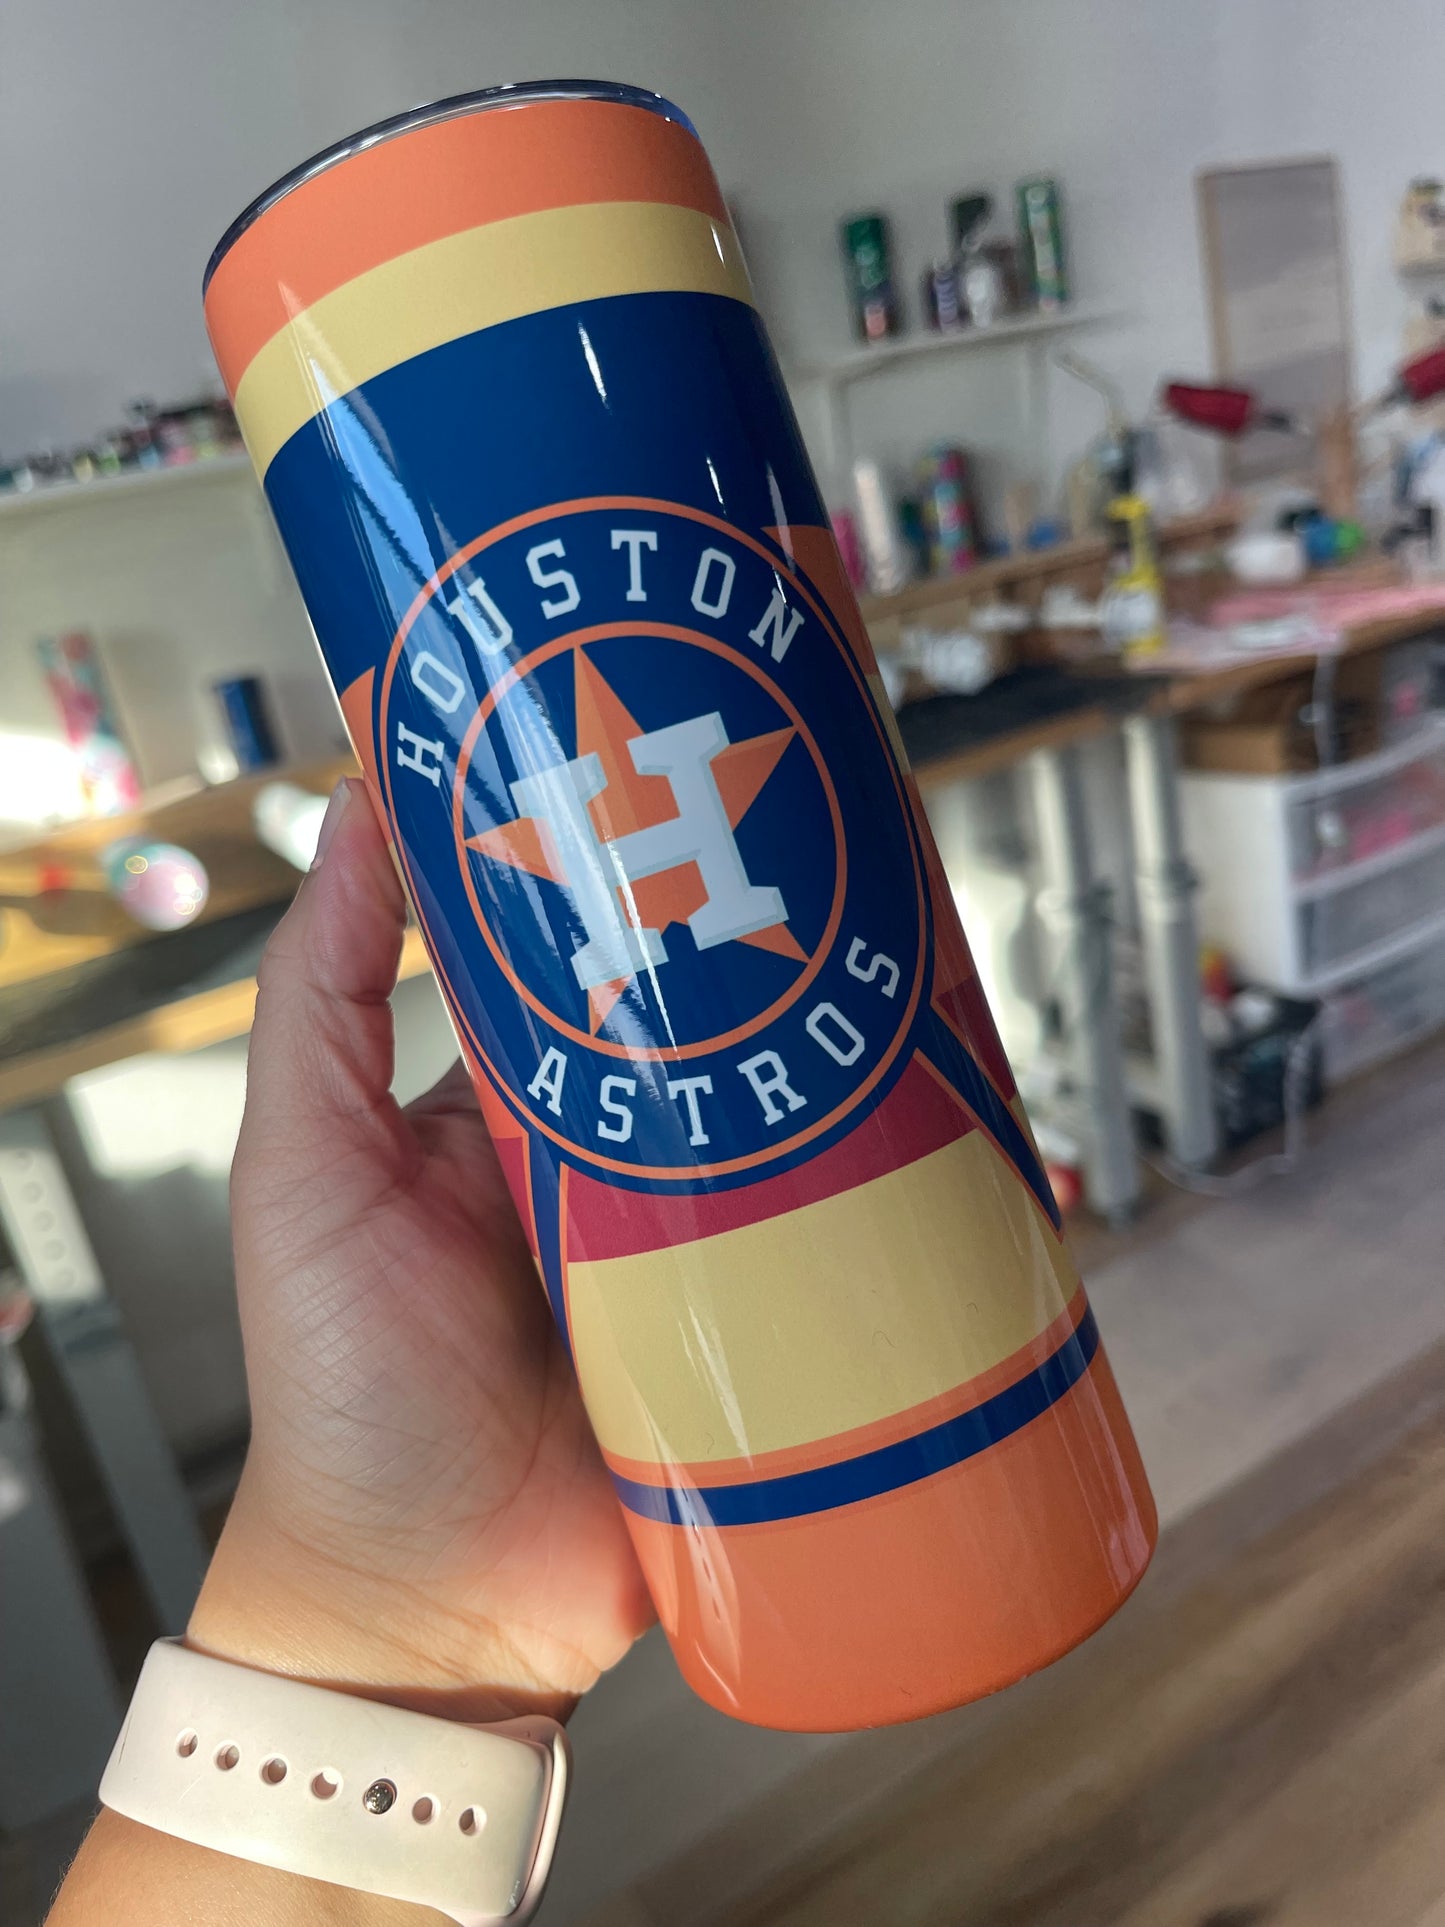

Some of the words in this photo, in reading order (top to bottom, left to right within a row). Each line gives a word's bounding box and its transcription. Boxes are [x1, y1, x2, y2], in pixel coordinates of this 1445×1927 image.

[396, 529, 805, 788] HOUSTON
[508, 710, 790, 990] H
[526, 937, 901, 1147] ASTROS
